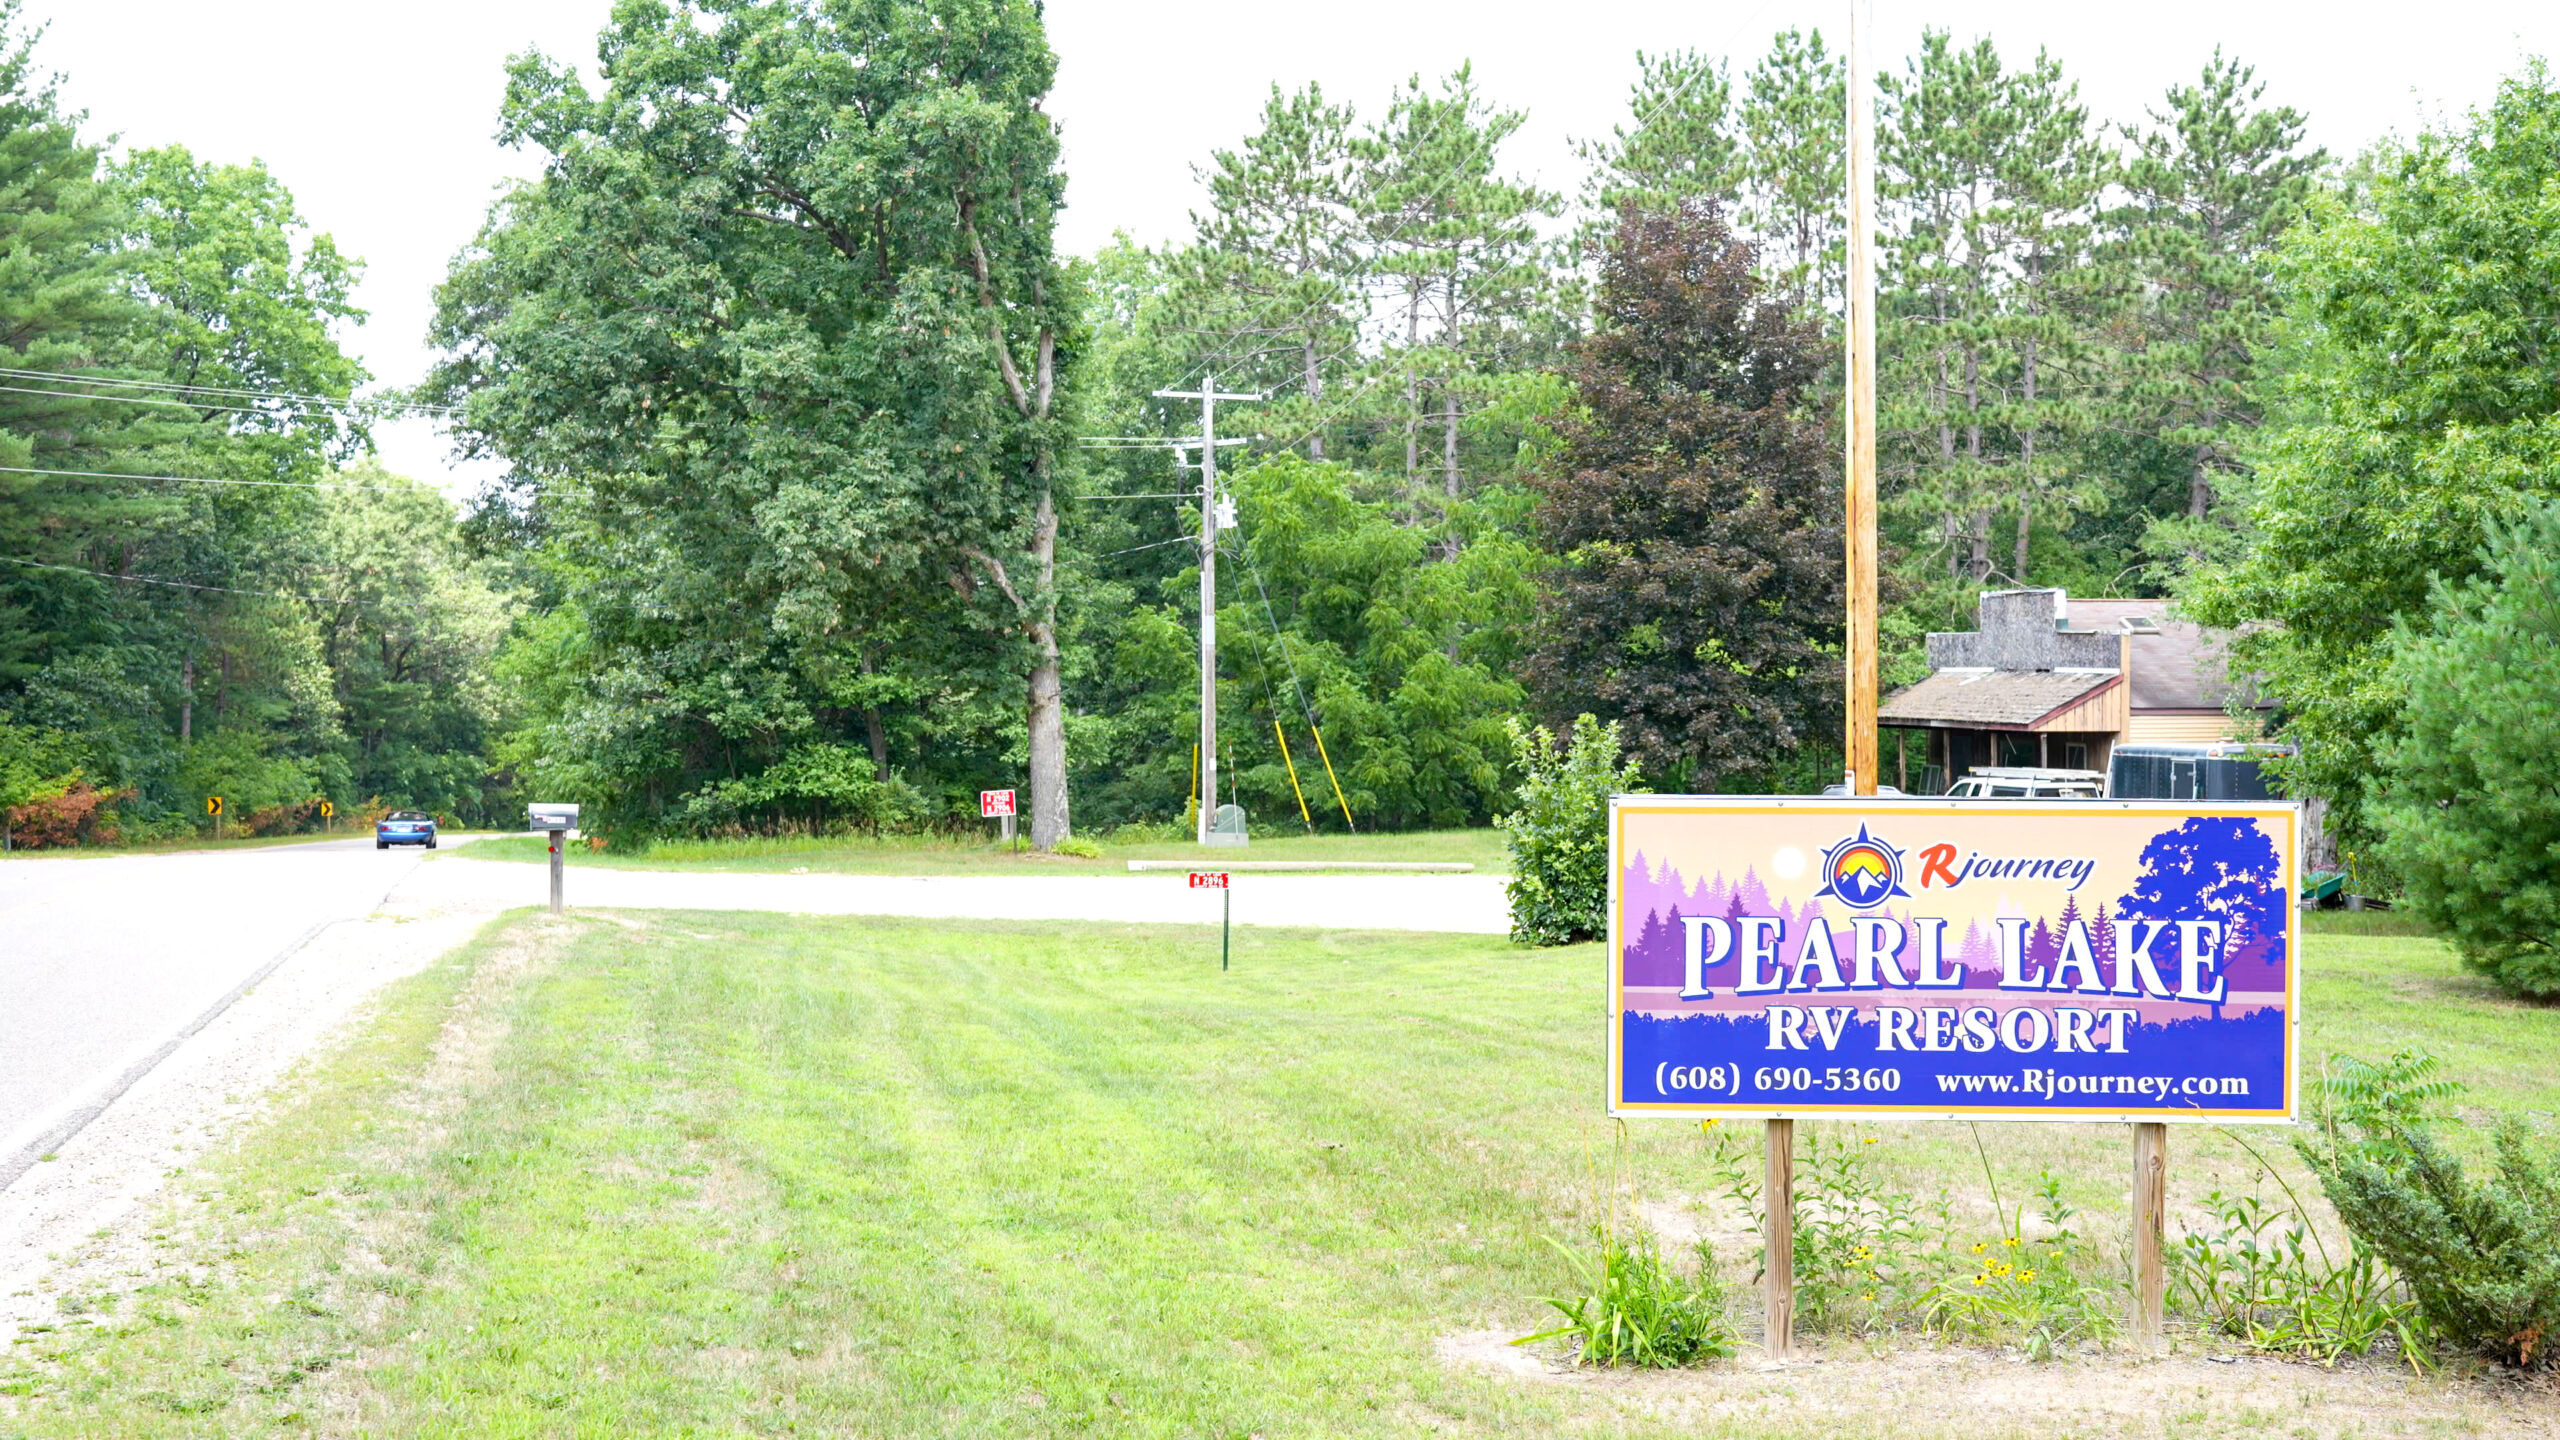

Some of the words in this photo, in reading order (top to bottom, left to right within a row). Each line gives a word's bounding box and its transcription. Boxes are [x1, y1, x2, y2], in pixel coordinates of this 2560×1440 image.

[1194, 876, 1200, 885] N
[1202, 876, 1224, 885] 2896
[1918, 842, 2095, 892] Rjourney
[1679, 915, 1966, 1001] PEARL
[1996, 917, 2228, 1006] LAKE
[1764, 1005, 1856, 1051] RV
[1874, 1006, 2139, 1054] RESORT
[1655, 1061, 1741, 1096] (608)
[1754, 1067, 1901, 1092] 690-5360
[1935, 1068, 2250, 1102] www.Rjourney.com
